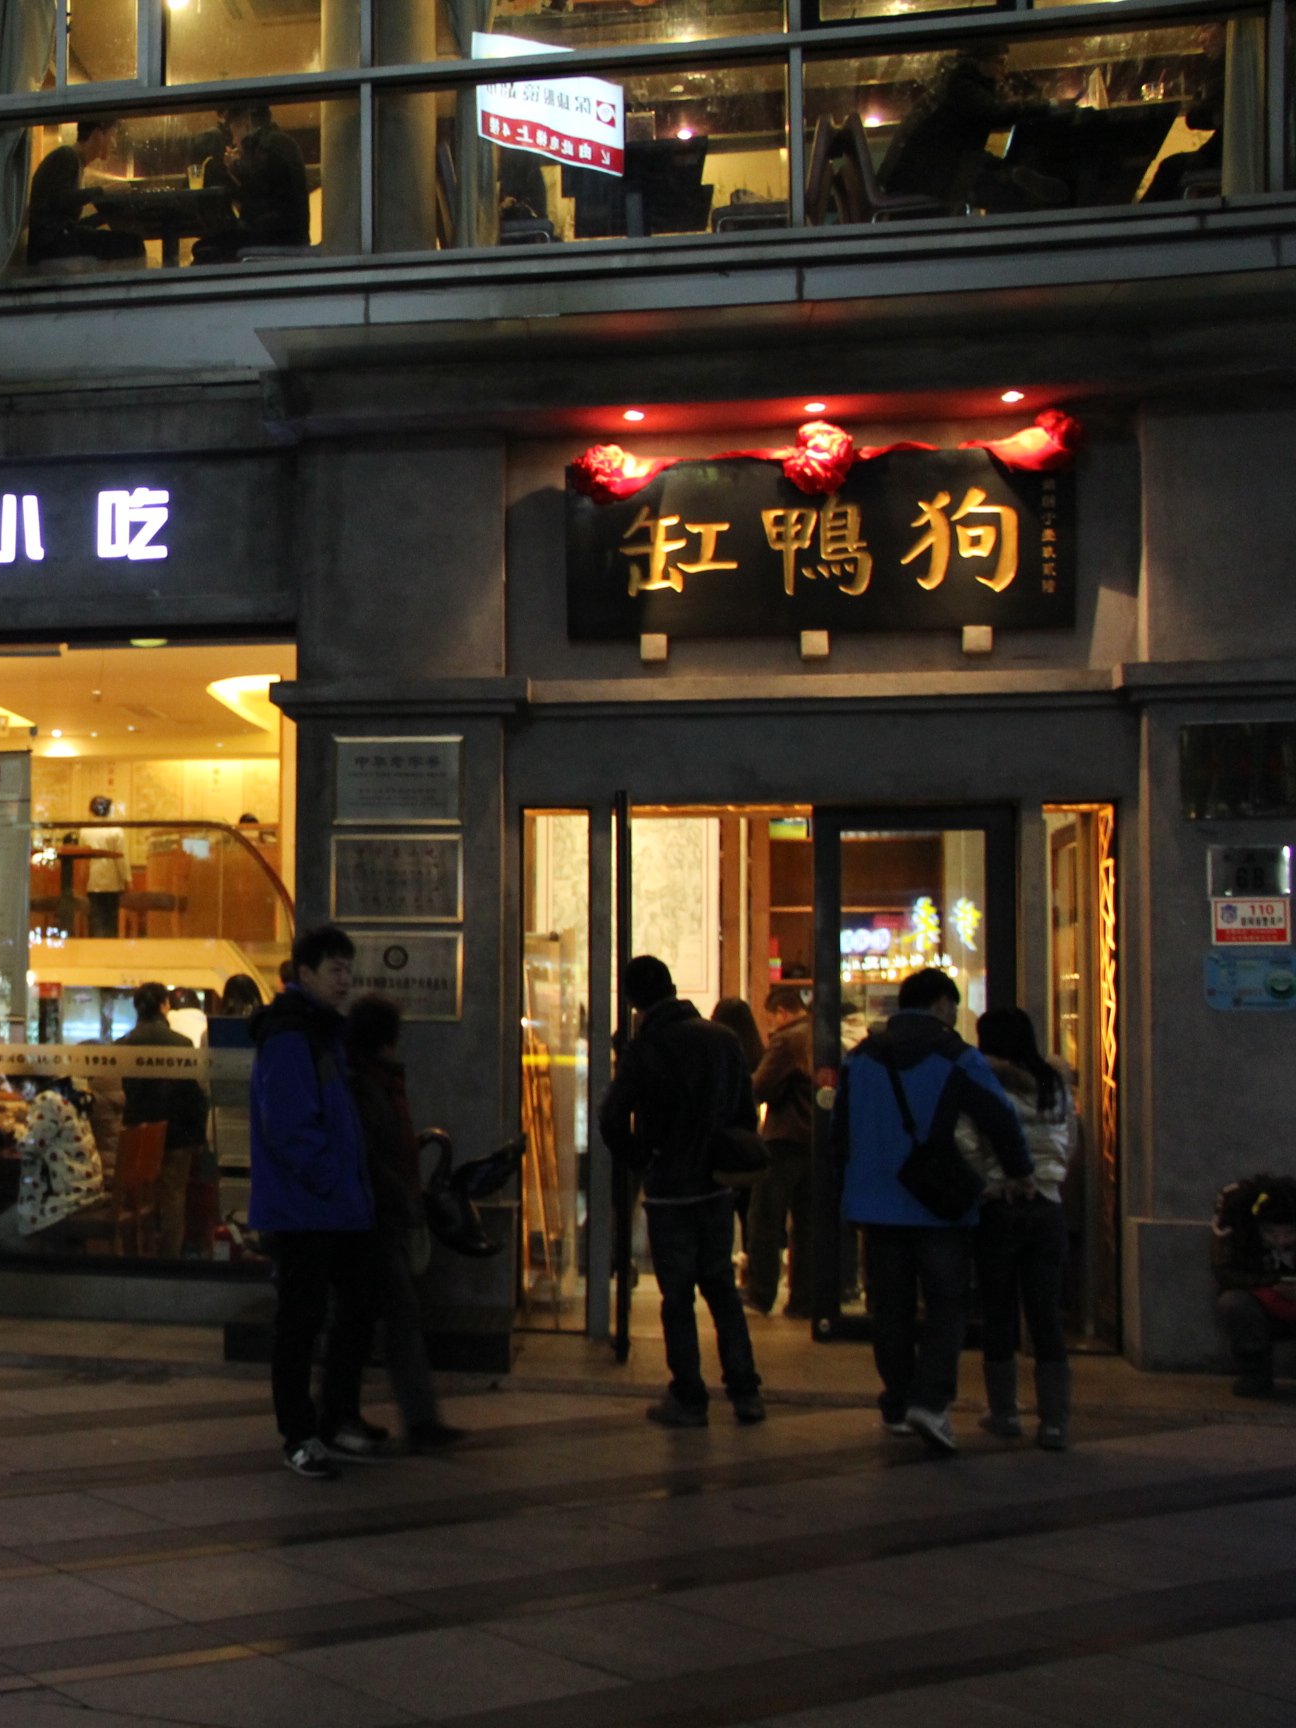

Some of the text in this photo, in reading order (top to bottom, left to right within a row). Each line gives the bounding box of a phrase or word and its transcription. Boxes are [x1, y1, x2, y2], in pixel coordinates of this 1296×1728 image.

[619, 486, 1019, 598] 缸鴨狗
[1249, 904, 1275, 916] 110
[85, 1055, 117, 1066] 1926
[136, 1057, 214, 1068] GANGYA
